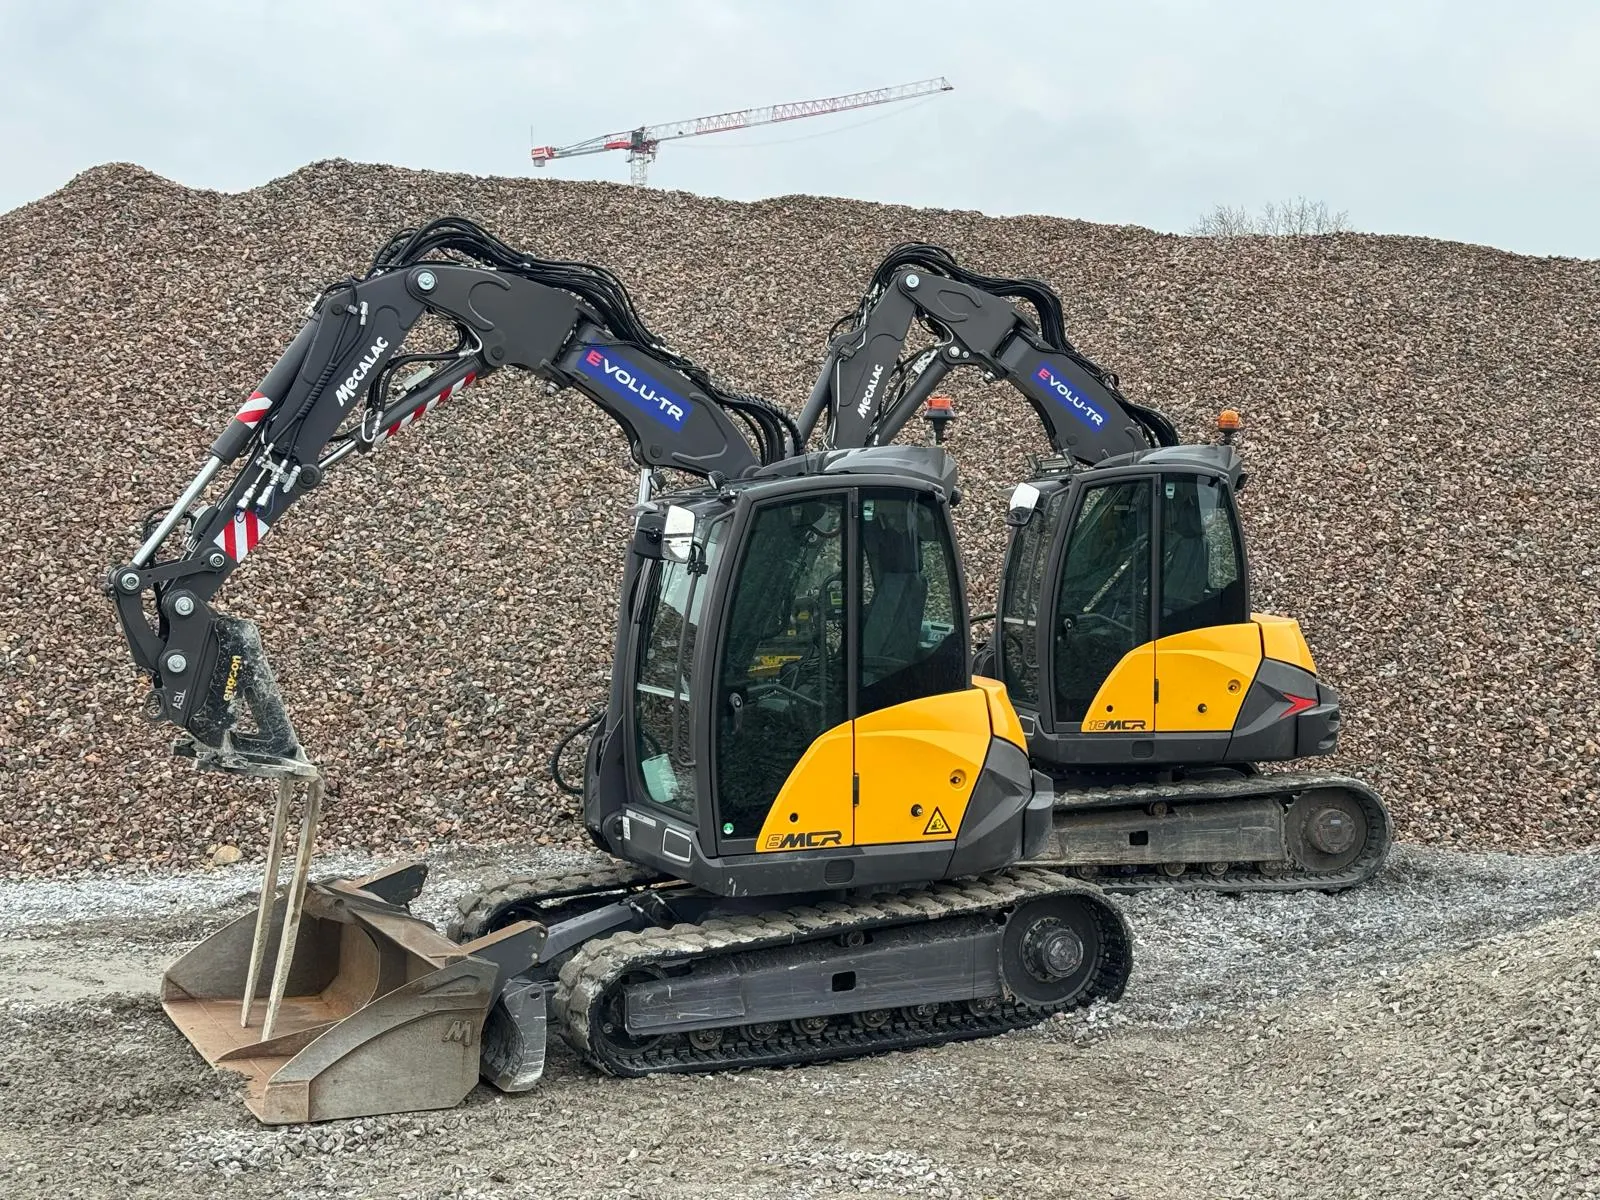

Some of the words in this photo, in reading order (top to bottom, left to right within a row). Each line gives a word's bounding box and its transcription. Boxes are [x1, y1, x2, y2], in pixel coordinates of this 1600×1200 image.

[585, 349, 684, 422] EVOLU-TR
[1037, 368, 1104, 426] EVOLU-TR
[223, 655, 242, 702] engcon
[1088, 720, 1147, 731] 10MCR
[765, 830, 843, 850] 8MCR
